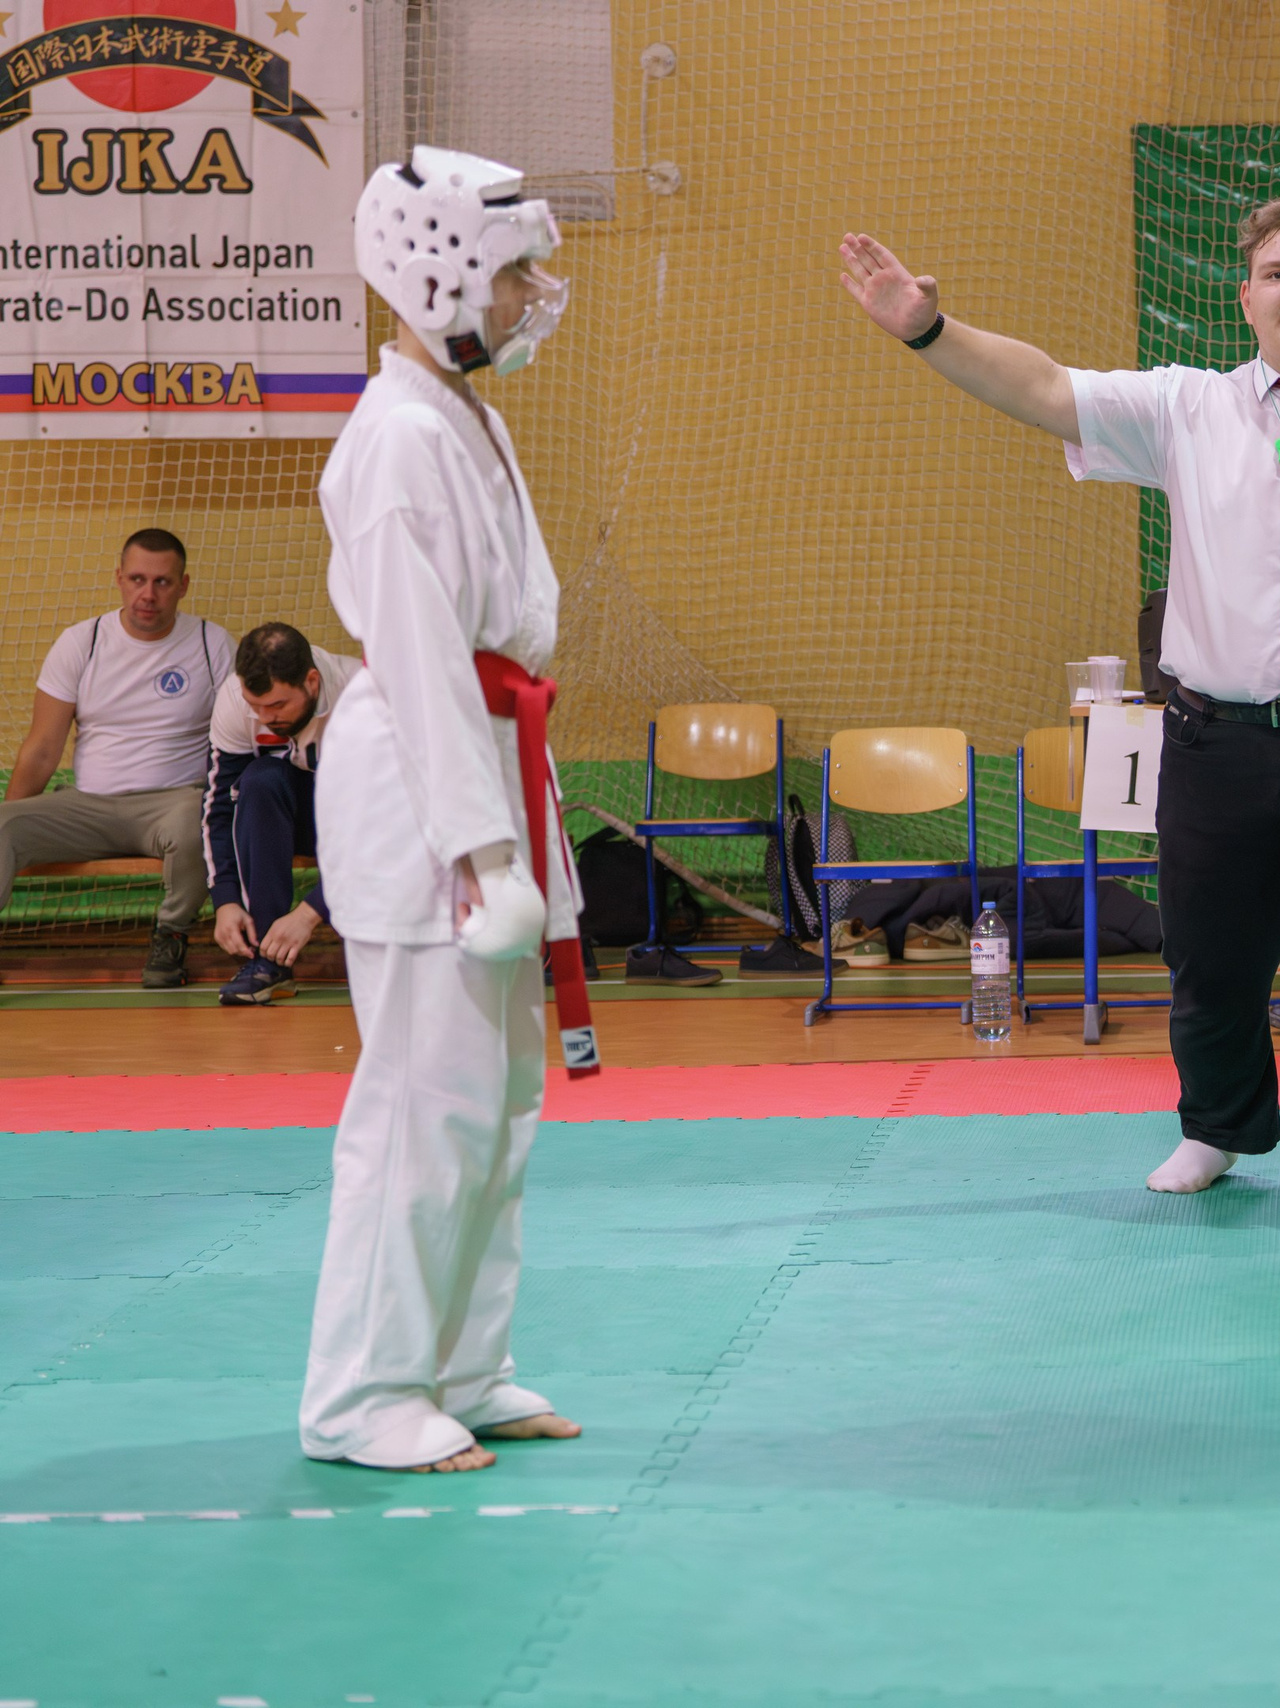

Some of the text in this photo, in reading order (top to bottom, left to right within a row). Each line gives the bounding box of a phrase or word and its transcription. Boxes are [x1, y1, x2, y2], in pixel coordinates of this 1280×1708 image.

[33, 128, 253, 195] IJKA
[212, 234, 313, 278] Japan
[141, 287, 342, 322] Association
[32, 361, 263, 406] МОСКВА
[1121, 750, 1142, 806] 1
